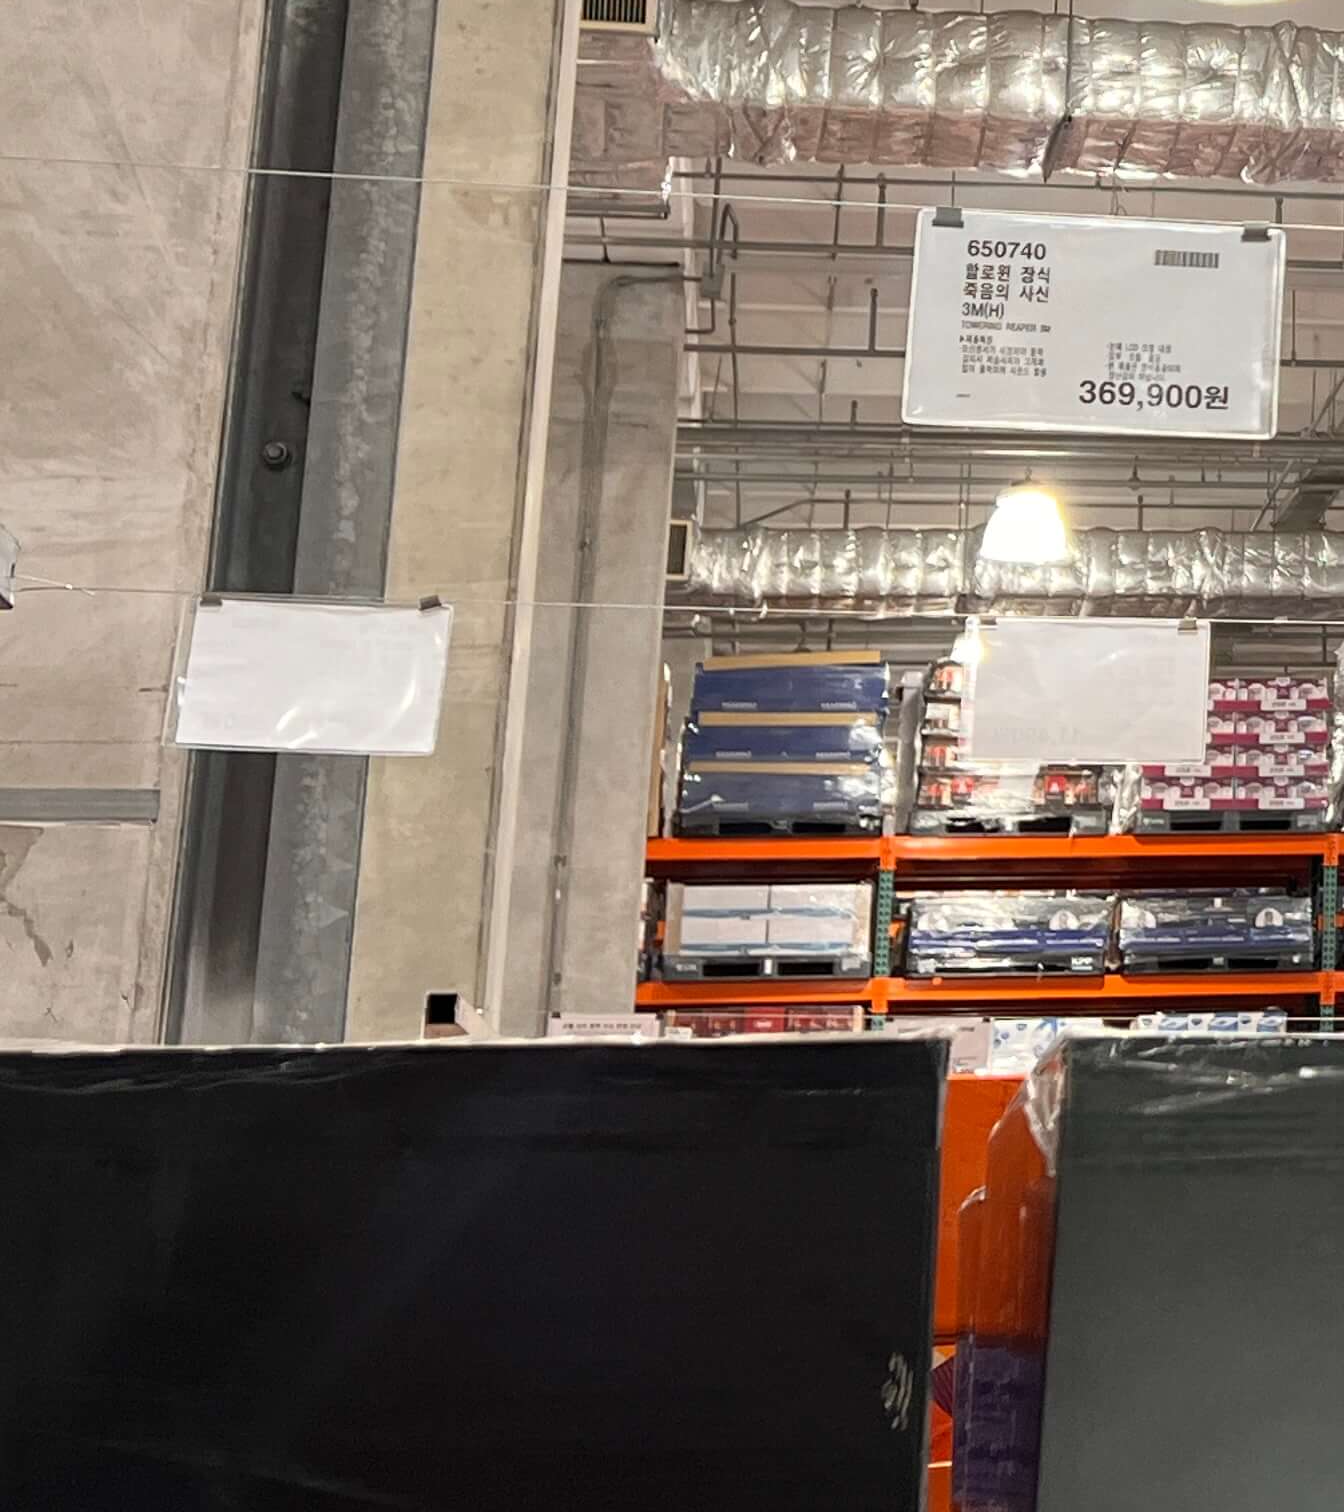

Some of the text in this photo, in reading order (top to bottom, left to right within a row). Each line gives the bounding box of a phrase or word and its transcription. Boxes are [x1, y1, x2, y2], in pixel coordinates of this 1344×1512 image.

[967, 240, 1047, 260] 650740
[966, 263, 1050, 284] 할로윈 장식
[963, 282, 1049, 303] 죽음의 사신
[962, 302, 1005, 320] 3M(H)
[1079, 380, 1229, 411] 369,900원
